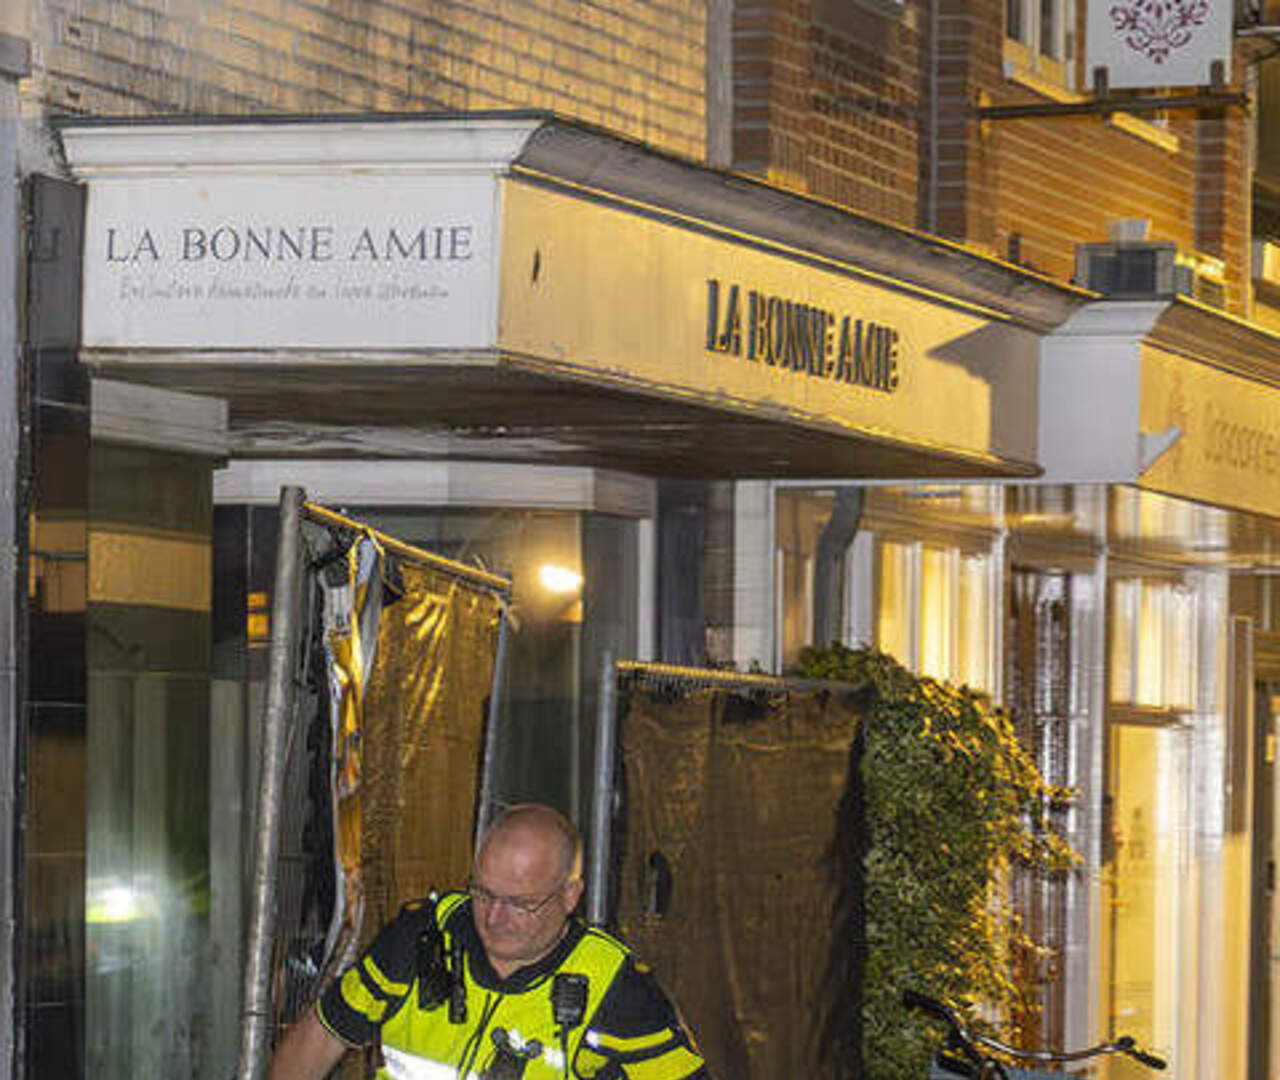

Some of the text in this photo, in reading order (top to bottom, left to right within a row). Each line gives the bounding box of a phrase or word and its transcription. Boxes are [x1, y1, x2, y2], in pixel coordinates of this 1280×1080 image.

[106, 226, 474, 262] LA BONNE AMIE
[705, 279, 899, 394] LA BONNE AMIE
